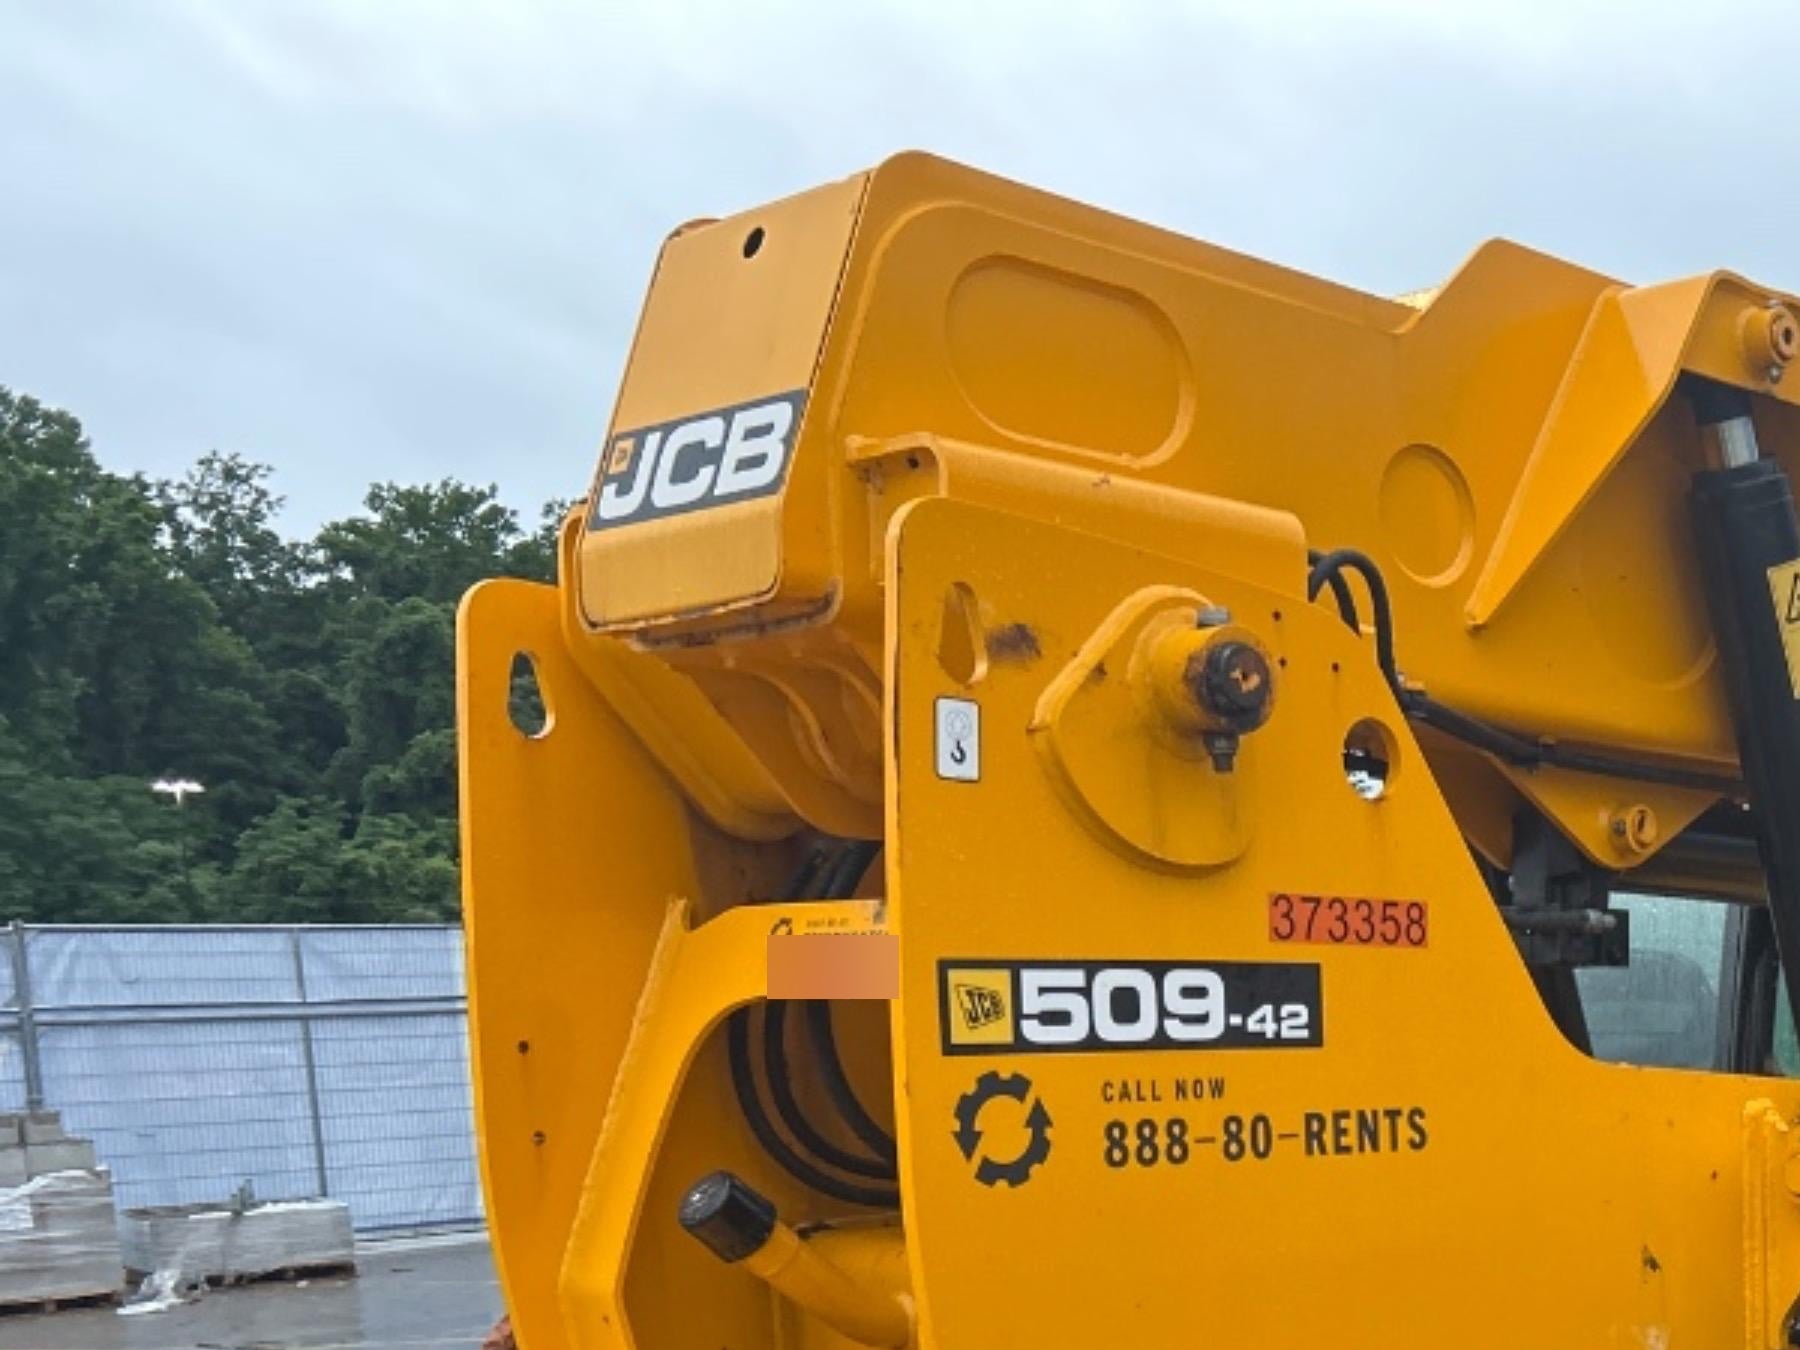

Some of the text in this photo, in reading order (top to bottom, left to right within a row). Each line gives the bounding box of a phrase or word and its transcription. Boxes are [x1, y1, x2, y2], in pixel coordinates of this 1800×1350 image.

[600, 400, 793, 519] JCB
[1272, 893, 1427, 946] 373358
[1019, 969, 1309, 1043] 509-42
[1102, 1078, 1226, 1103] CALL NOW
[1103, 1106, 1429, 1168] 888-80-RENTS
